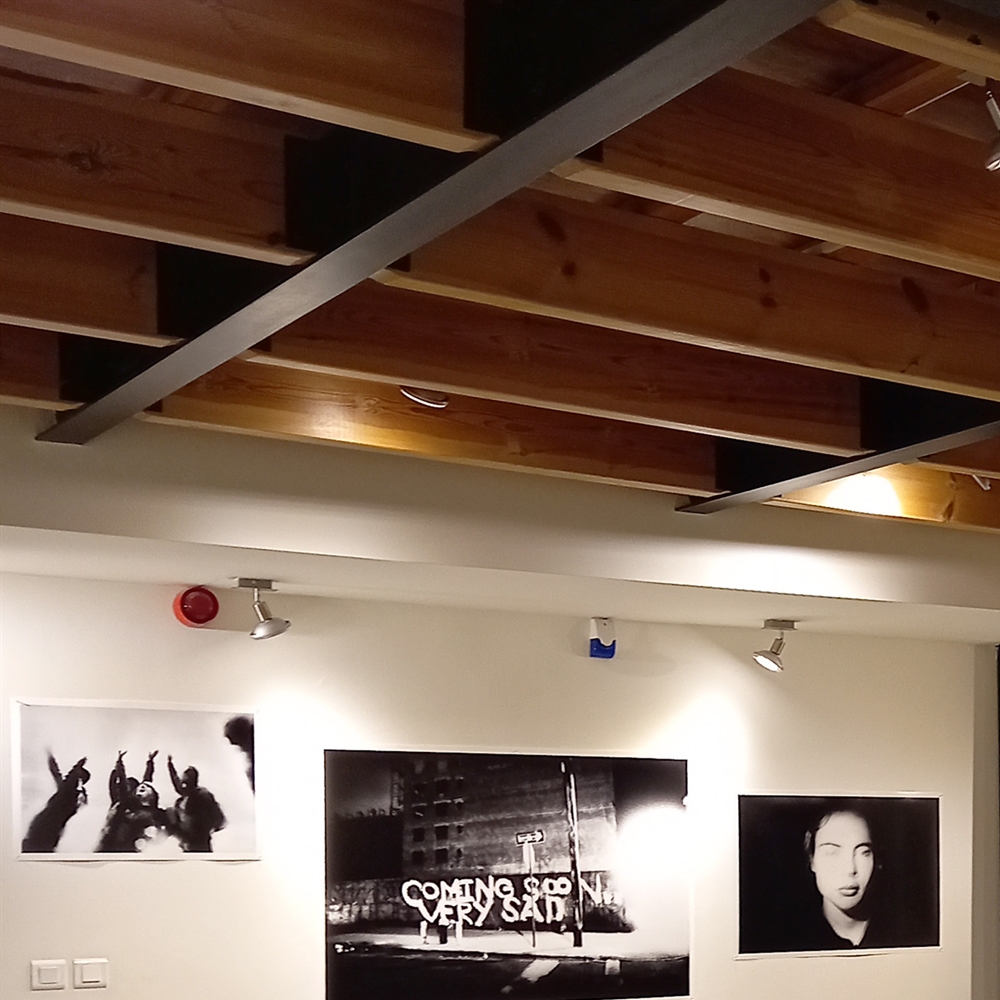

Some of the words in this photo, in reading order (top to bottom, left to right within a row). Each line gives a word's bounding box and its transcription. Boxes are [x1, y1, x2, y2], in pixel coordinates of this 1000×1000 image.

[402, 874, 514, 907] COMING
[417, 899, 494, 927] VERY
[502, 893, 565, 924] SAD
